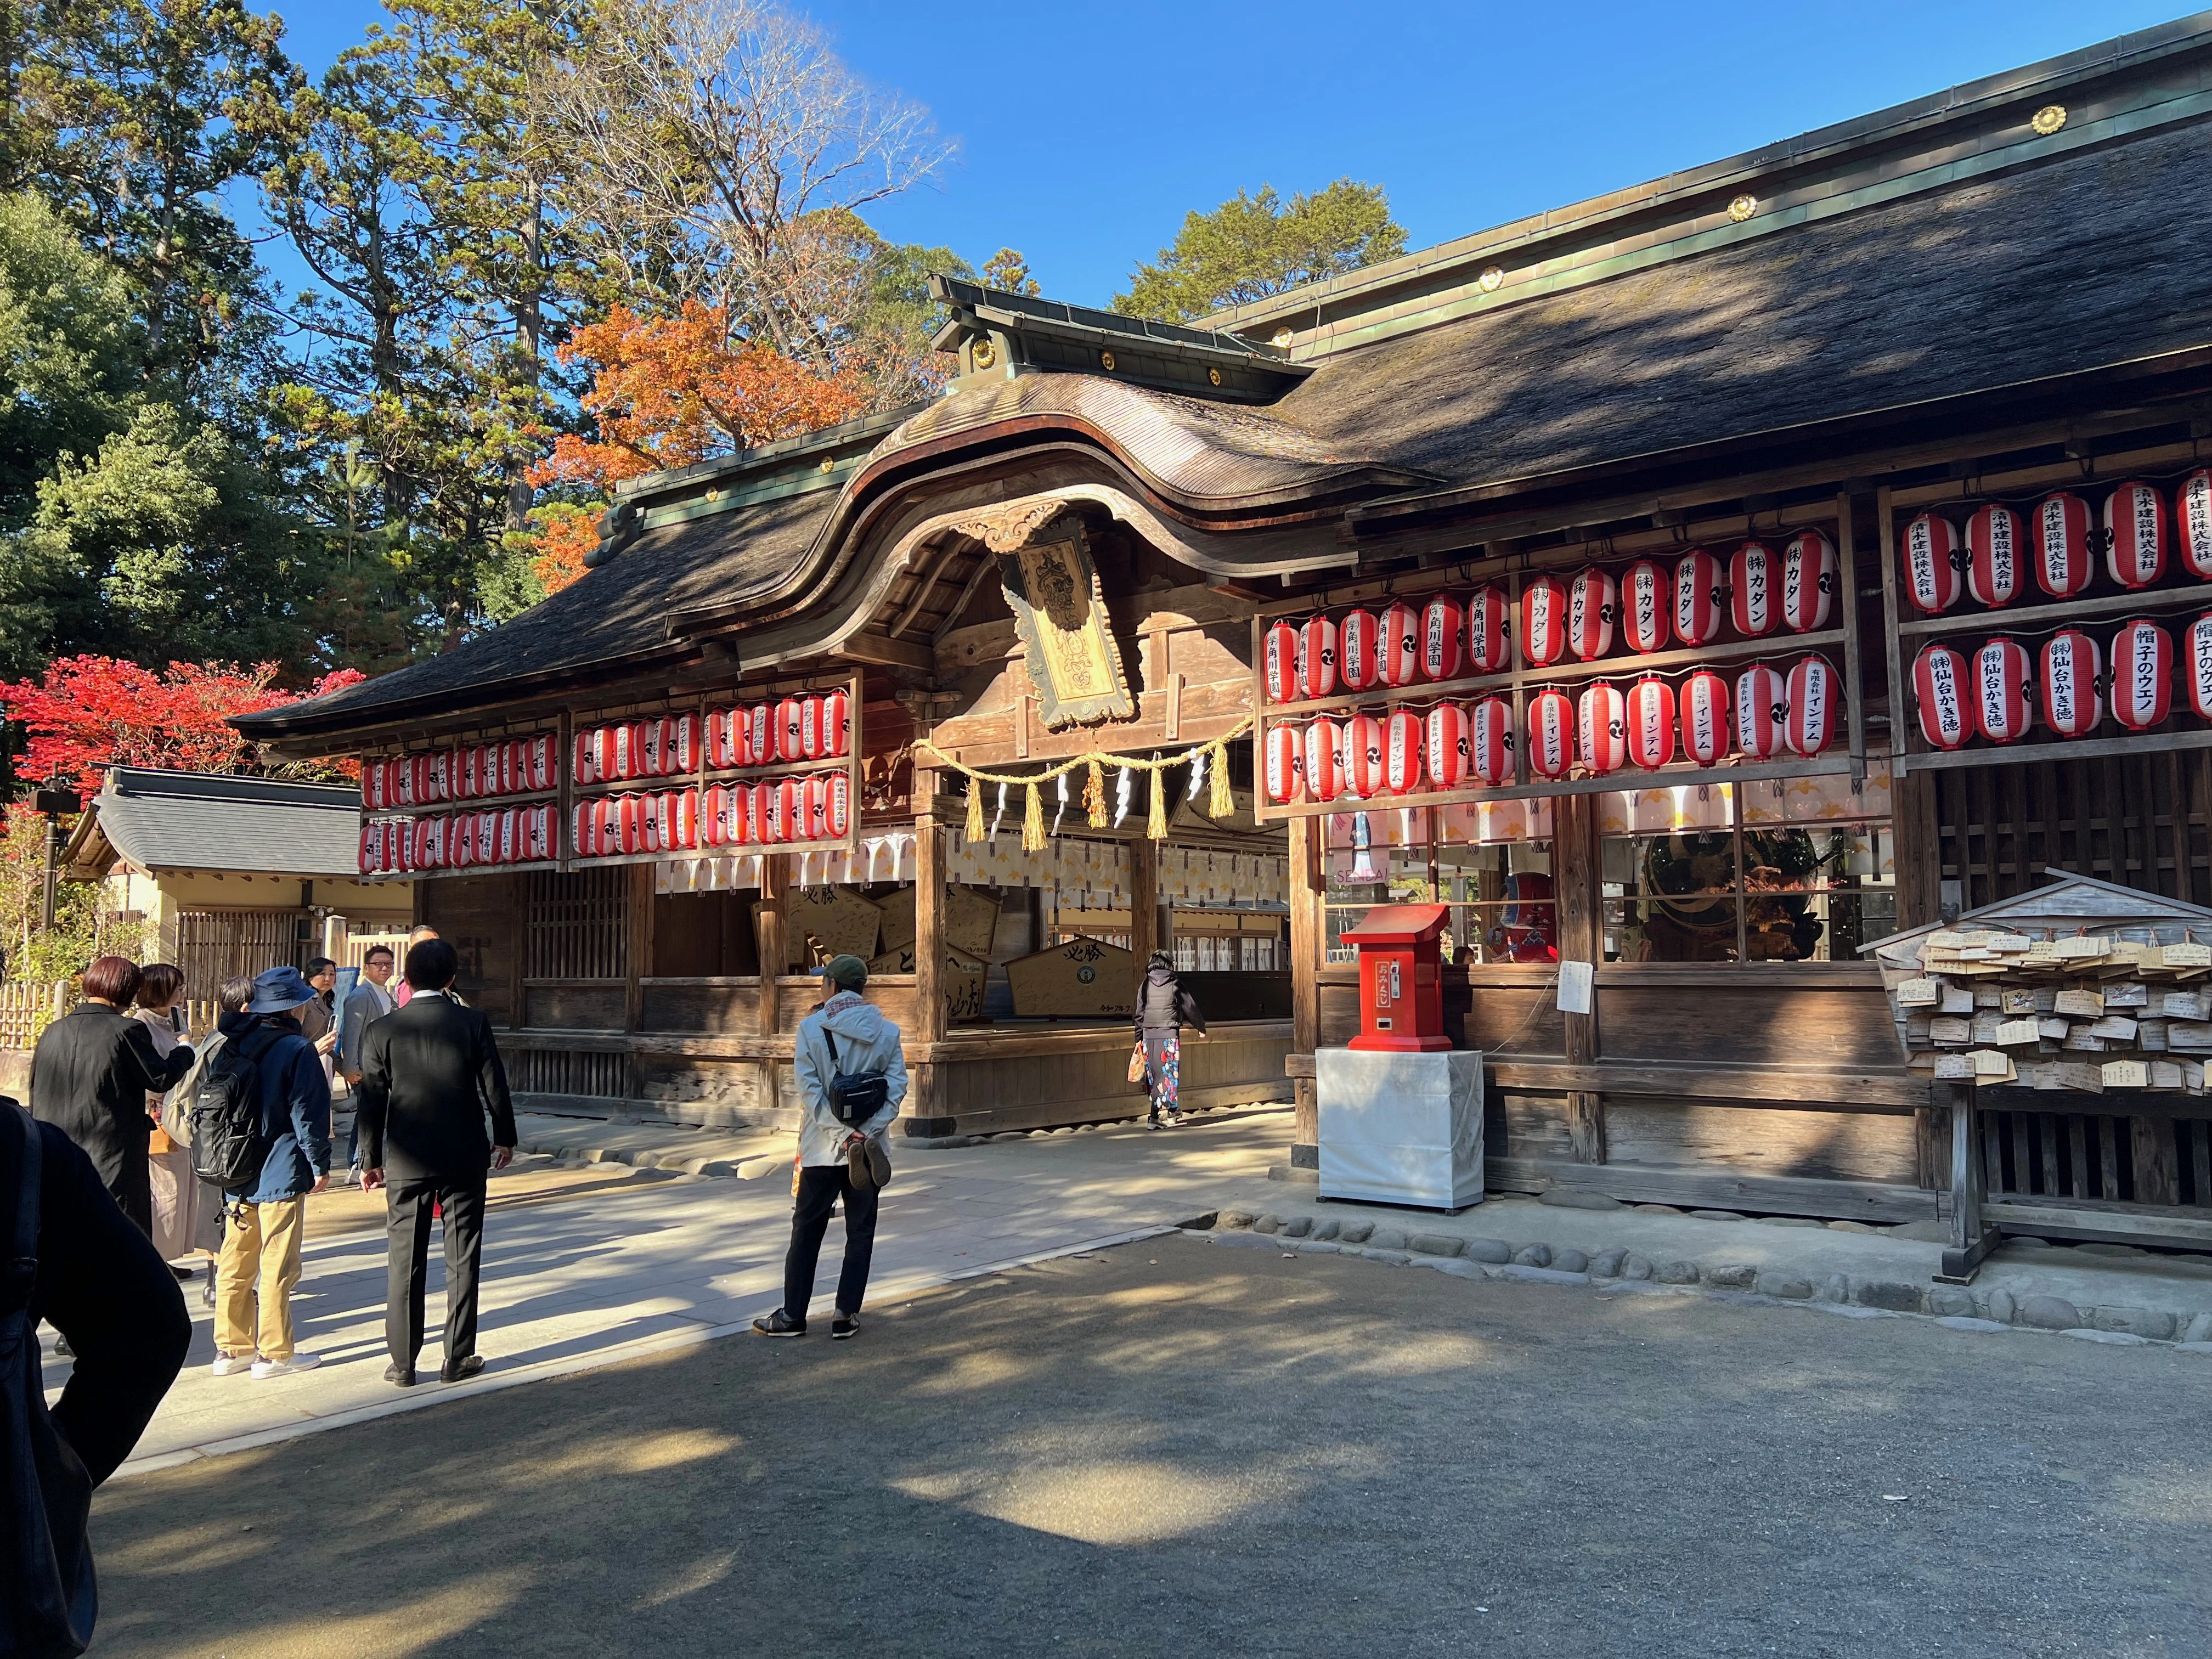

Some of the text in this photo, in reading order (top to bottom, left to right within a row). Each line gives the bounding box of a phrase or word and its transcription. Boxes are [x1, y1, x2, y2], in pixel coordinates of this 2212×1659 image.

[1992, 511, 2012, 589] 清水建設株式会社
[2045, 501, 2067, 580] 清水建設株式会社
[2135, 489, 2157, 569] 清水建設株式会社
[2188, 479, 2212, 561] 清水建設株式会社
[1911, 522, 1933, 597] 清水建設株式会社
[2135, 631, 2156, 710] 帽子のウエノ
[1337, 868, 1387, 883] SENDAI
[1063, 943, 1106, 962] 必勝
[1379, 965, 1388, 1005] おみくじ
